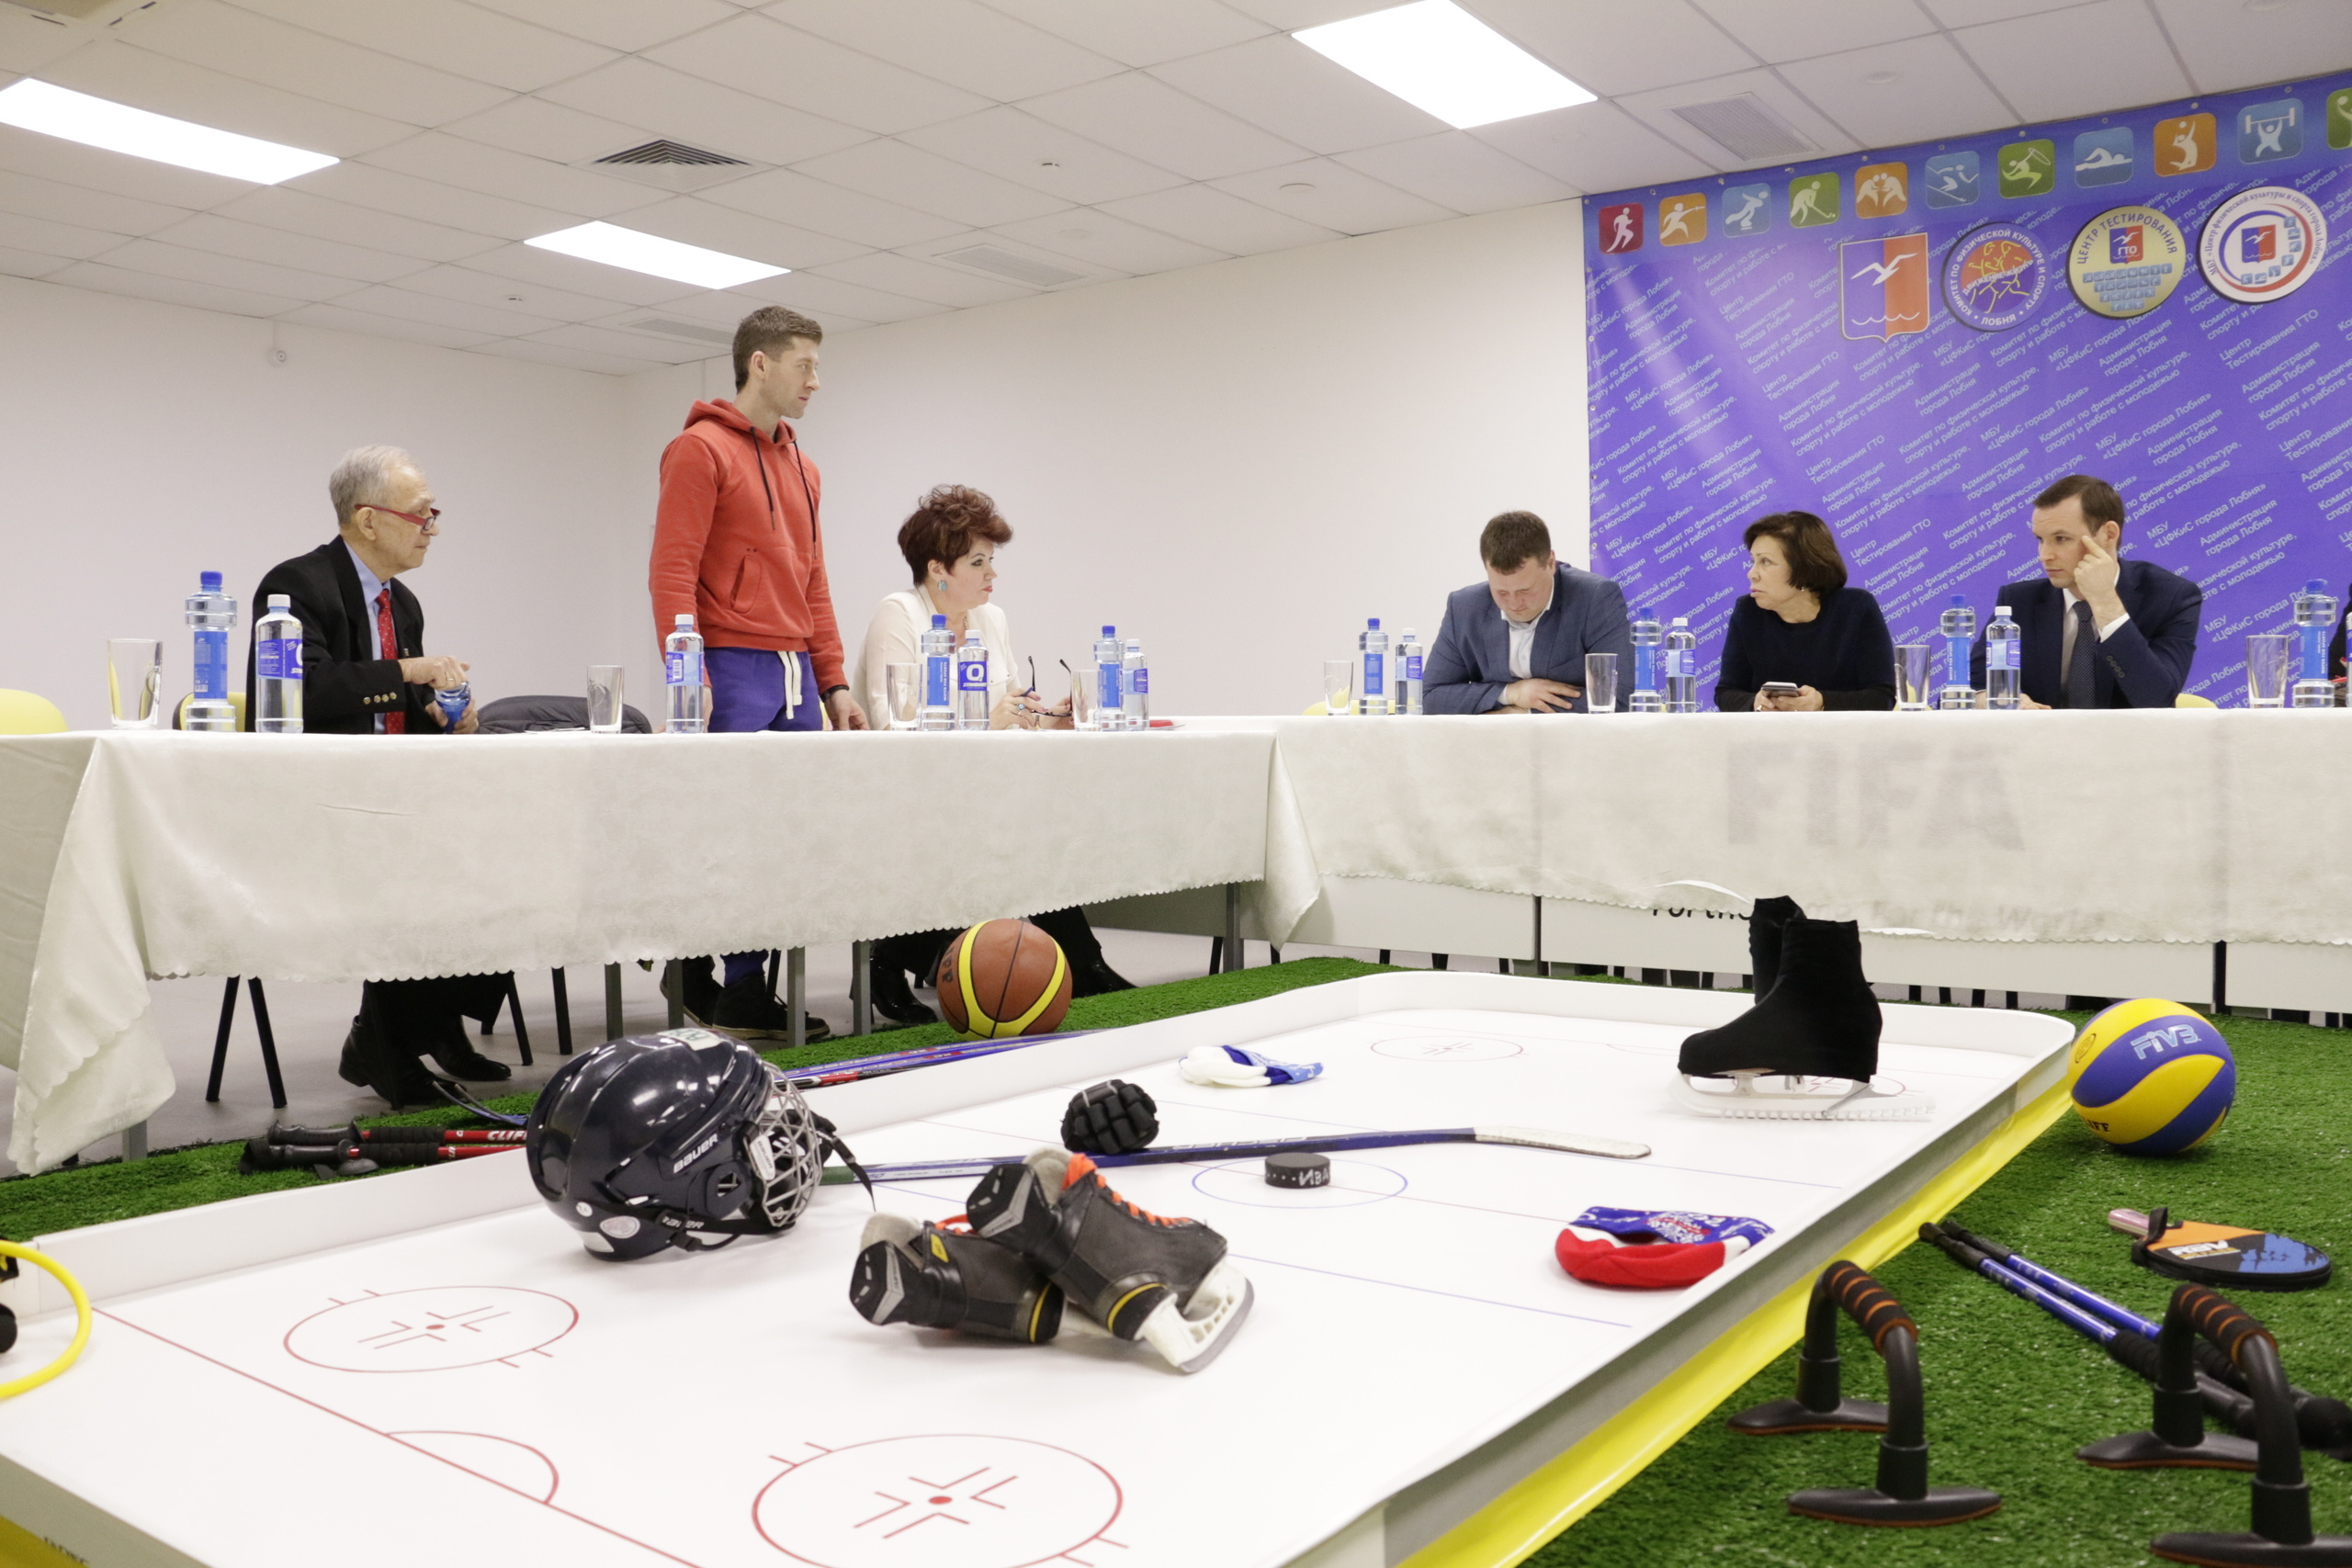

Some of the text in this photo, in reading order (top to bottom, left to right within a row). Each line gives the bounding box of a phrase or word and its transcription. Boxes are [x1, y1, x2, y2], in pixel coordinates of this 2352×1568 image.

[1957, 229, 2010, 262] ФИЗИЧЕСКОЙ
[2012, 231, 2044, 265] КУЛЬТУРЕ
[2077, 213, 2177, 265] ЦЕНТР ТЕСТИРОВАНИЯ
[2119, 246, 2137, 255] ГТО
[1704, 265, 1736, 288] Комитет
[1710, 254, 1770, 297] спорту работе
[1951, 264, 1960, 276] ПО
[1593, 276, 1673, 335] «ЦФКиС города Лобня»
[1724, 272, 1794, 322] Тестирования ГТО
[1951, 279, 1973, 316] КОМИТЕТ
[2025, 276, 2045, 310] СПОРТУ
[1629, 304, 1678, 340] города Лобня
[1739, 312, 1792, 350] города Лобня
[1981, 314, 2016, 325] ЛОБНЯ
[2225, 310, 2318, 370] Тестирования ГТО
[1853, 349, 1887, 372] Комитет
[2098, 319, 2172, 367] Администрация
[2105, 335, 2167, 377] города Лобня
[2220, 337, 2252, 361] Центр
[1631, 353, 1714, 411] «ЦФКиС города Лобня»
[1664, 367, 1723, 408] Администрация
[1762, 374, 1788, 393] Центр
[2242, 341, 2321, 393] Администрация
[2248, 358, 2316, 403] города Лобня
[1830, 378, 1914, 436] работе молодежью
[1836, 362, 1924, 423] физической культуре,
[1899, 366, 2040, 455] Комитет физической культуре,
[1920, 378, 1976, 417] города Лобня
[2085, 368, 2180, 431] работе молодежью
[2258, 392, 2301, 421] Комитет
[2266, 378, 2346, 431] спорту работе
[1617, 396, 1736, 475] Комитет физической культуре,
[1905, 383, 2030, 464] спорту работе молодежью
[1981, 424, 2001, 442] МБУ
[1987, 386, 2089, 451] «ЦФКиС города Лобня»
[2103, 393, 2211, 460] «ЦФКиС города Лобня»
[2147, 409, 2222, 456] Администрация
[2278, 429, 2312, 452] Центр
[1607, 424, 1657, 463] города Лобня»
[1622, 412, 1729, 484] спорту работе молодежью
[1667, 434, 1753, 491] «ЦФКиС города Лобня»
[2153, 425, 2218, 467] города Лобня
[1706, 462, 1758, 498] города Лобня
[1805, 457, 1832, 477] Центр
[1835, 445, 1971, 530] Комитет физической культуре,
[1962, 447, 2030, 492] Администрация
[2139, 441, 2242, 502] физической культуре,
[2174, 460, 2231, 495] молодежью
[1622, 485, 1654, 509] культуре,
[1654, 477, 1776, 555] Комитет физической культуре,
[1840, 462, 1961, 539] спорту работе молодежью
[1942, 453, 2086, 540] Комитет физической культуре,
[2154, 482, 2267, 548] «ЦФКиС города Лобня»
[1611, 505, 1693, 559] «ЦФКиС города Лобня»
[1658, 493, 1767, 564] спорту работе молодежью
[1855, 518, 1931, 567] Тестирования ГТО
[2199, 499, 2278, 546] Администрация
[1700, 547, 1718, 563] МБУ
[1706, 547, 1738, 572] «ЦФКиС
[1864, 547, 1928, 589] Администрация
[1918, 548, 2006, 604] работе молодежью
[2228, 551, 2285, 588] молодежью
[2212, 598, 2289, 644] «ЦФКиС города
[967, 663, 985, 682] Q
[673, 1134, 718, 1174] BAUER
